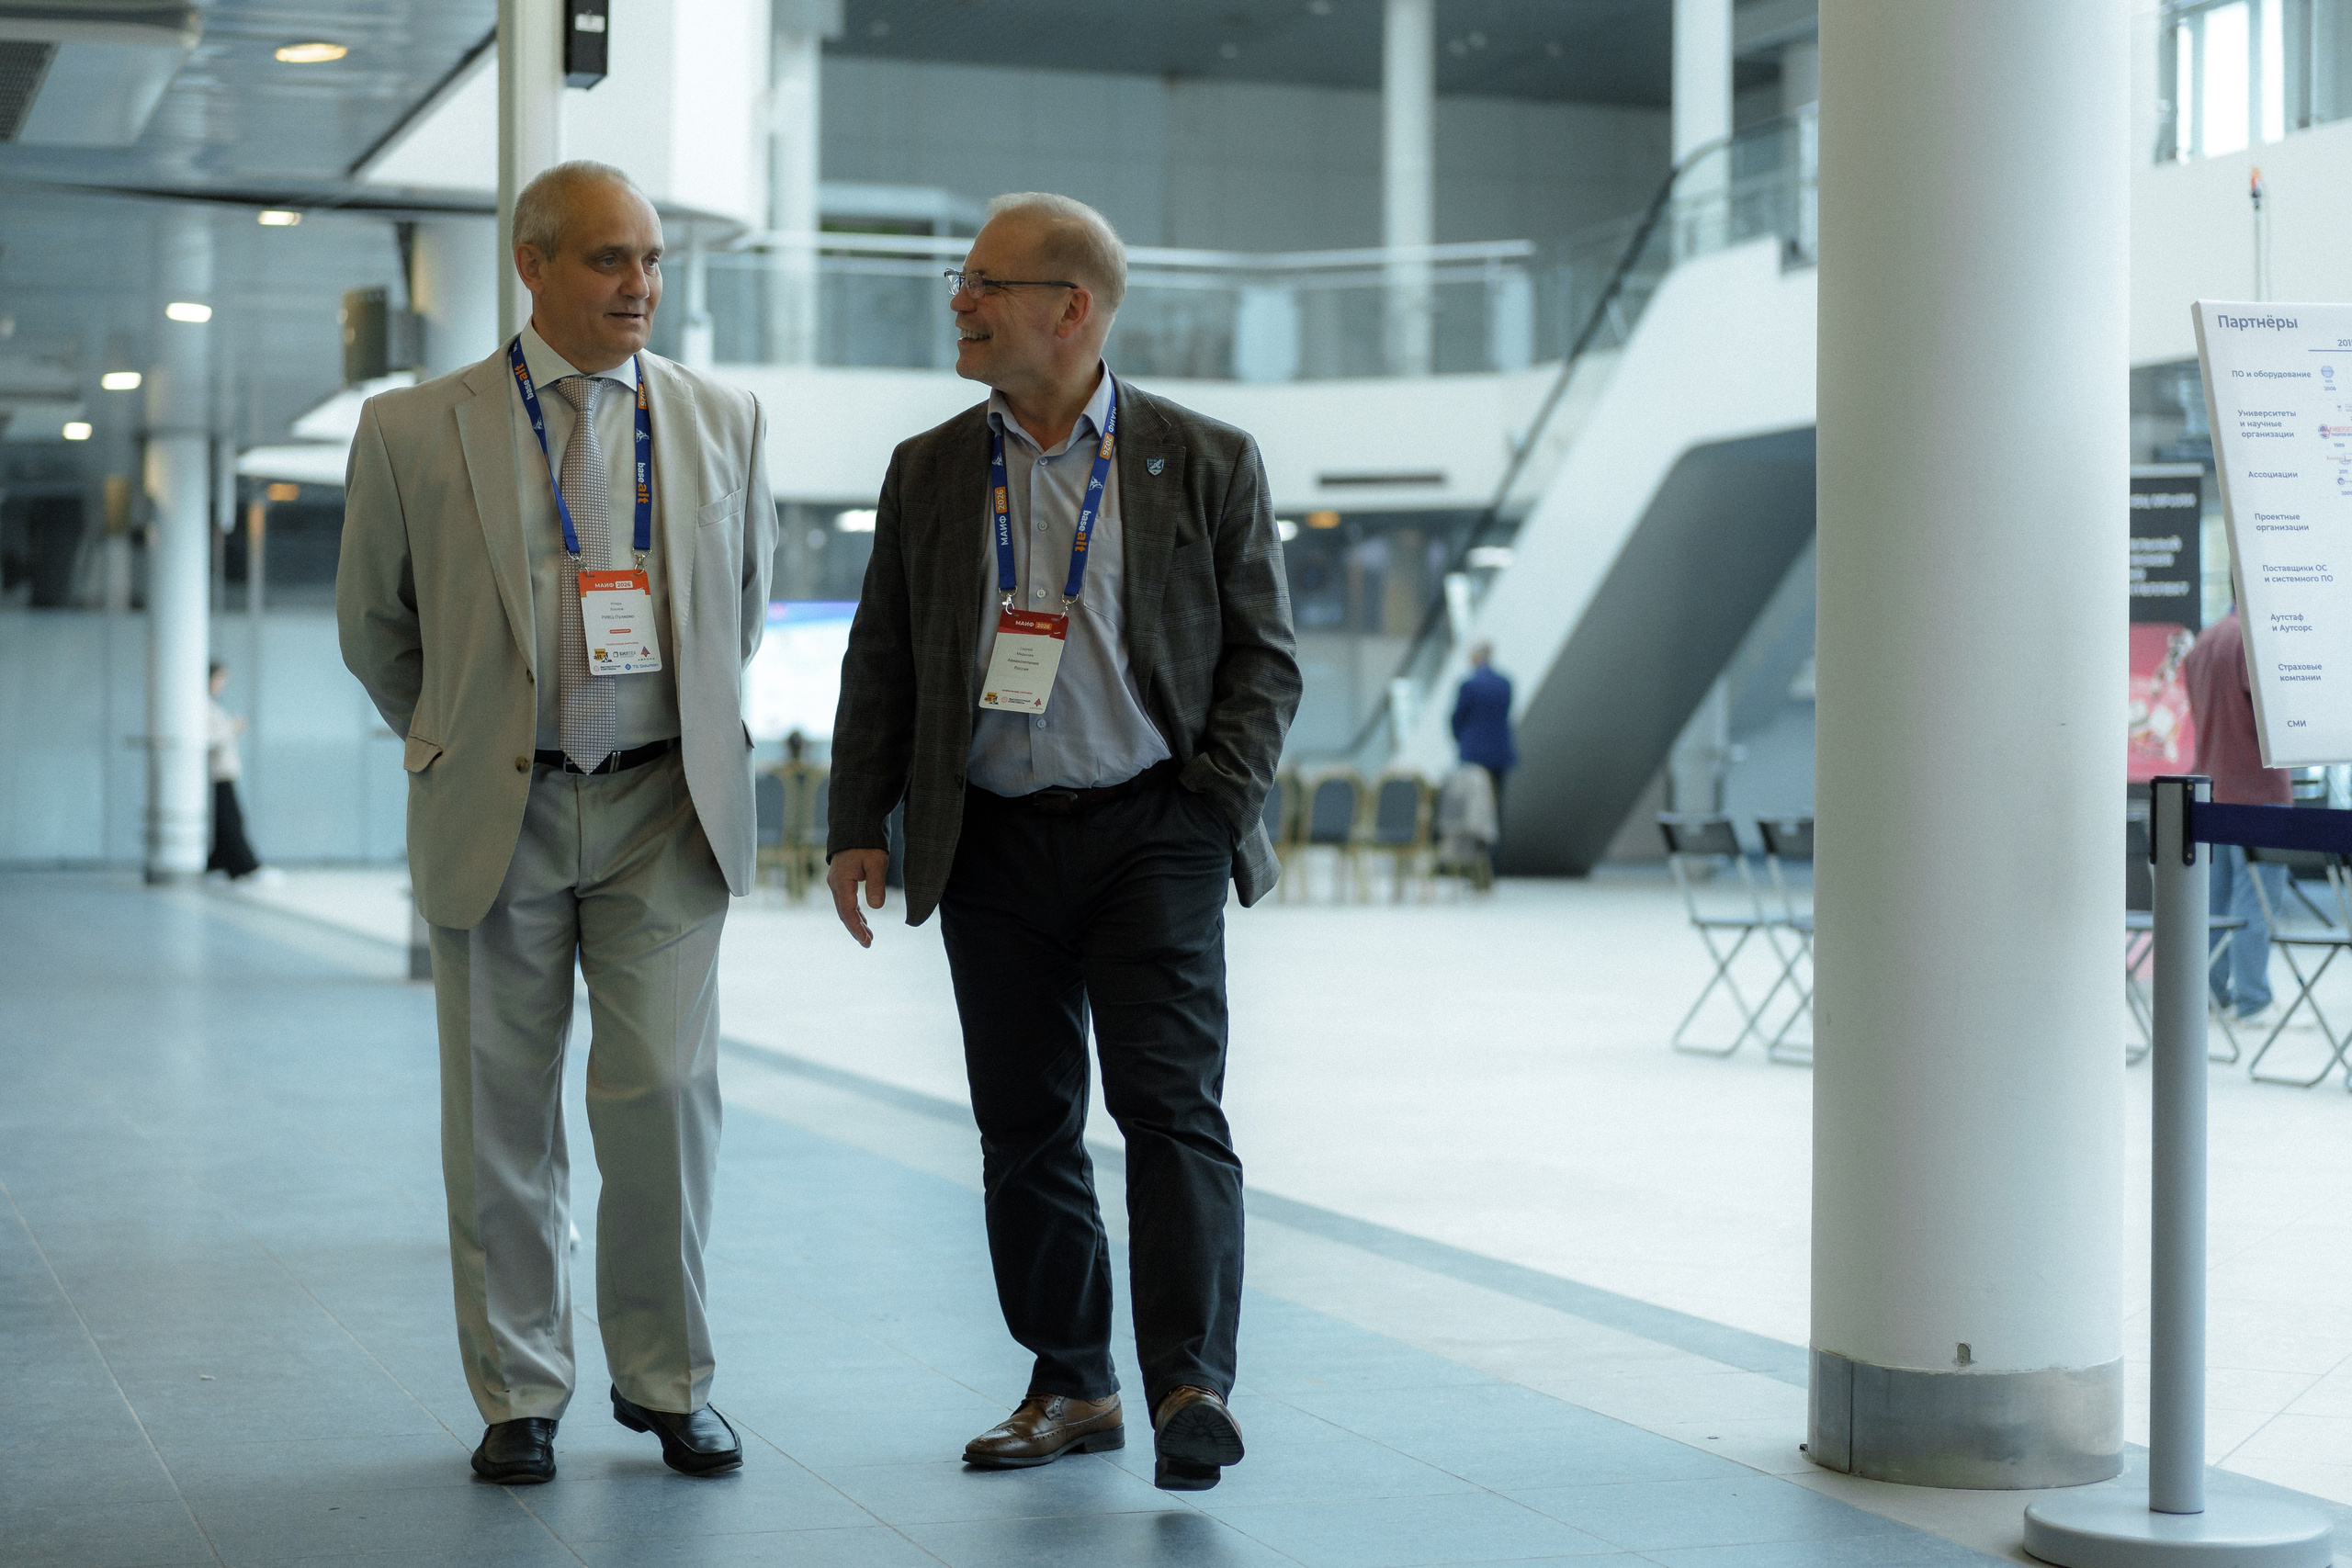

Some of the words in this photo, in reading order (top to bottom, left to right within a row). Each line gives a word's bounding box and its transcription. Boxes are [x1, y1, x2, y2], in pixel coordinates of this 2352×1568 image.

[2217, 315, 2298, 331] Партнёры
[2337, 339, 2352, 347] 201
[2254, 370, 2312, 379] оборудование
[2238, 410, 2296, 418] Университеты
[1102, 435, 1112, 456] 2026
[638, 462, 650, 503] basealt
[997, 489, 1005, 510] 2026
[2255, 513, 2301, 521] Проектные
[999, 515, 1008, 546] МАИФ
[1074, 510, 1091, 552] basealt
[2271, 613, 2304, 622] Аутстаф
[2280, 624, 2313, 633] Аутсорс
[2278, 664, 2322, 672] Страховые
